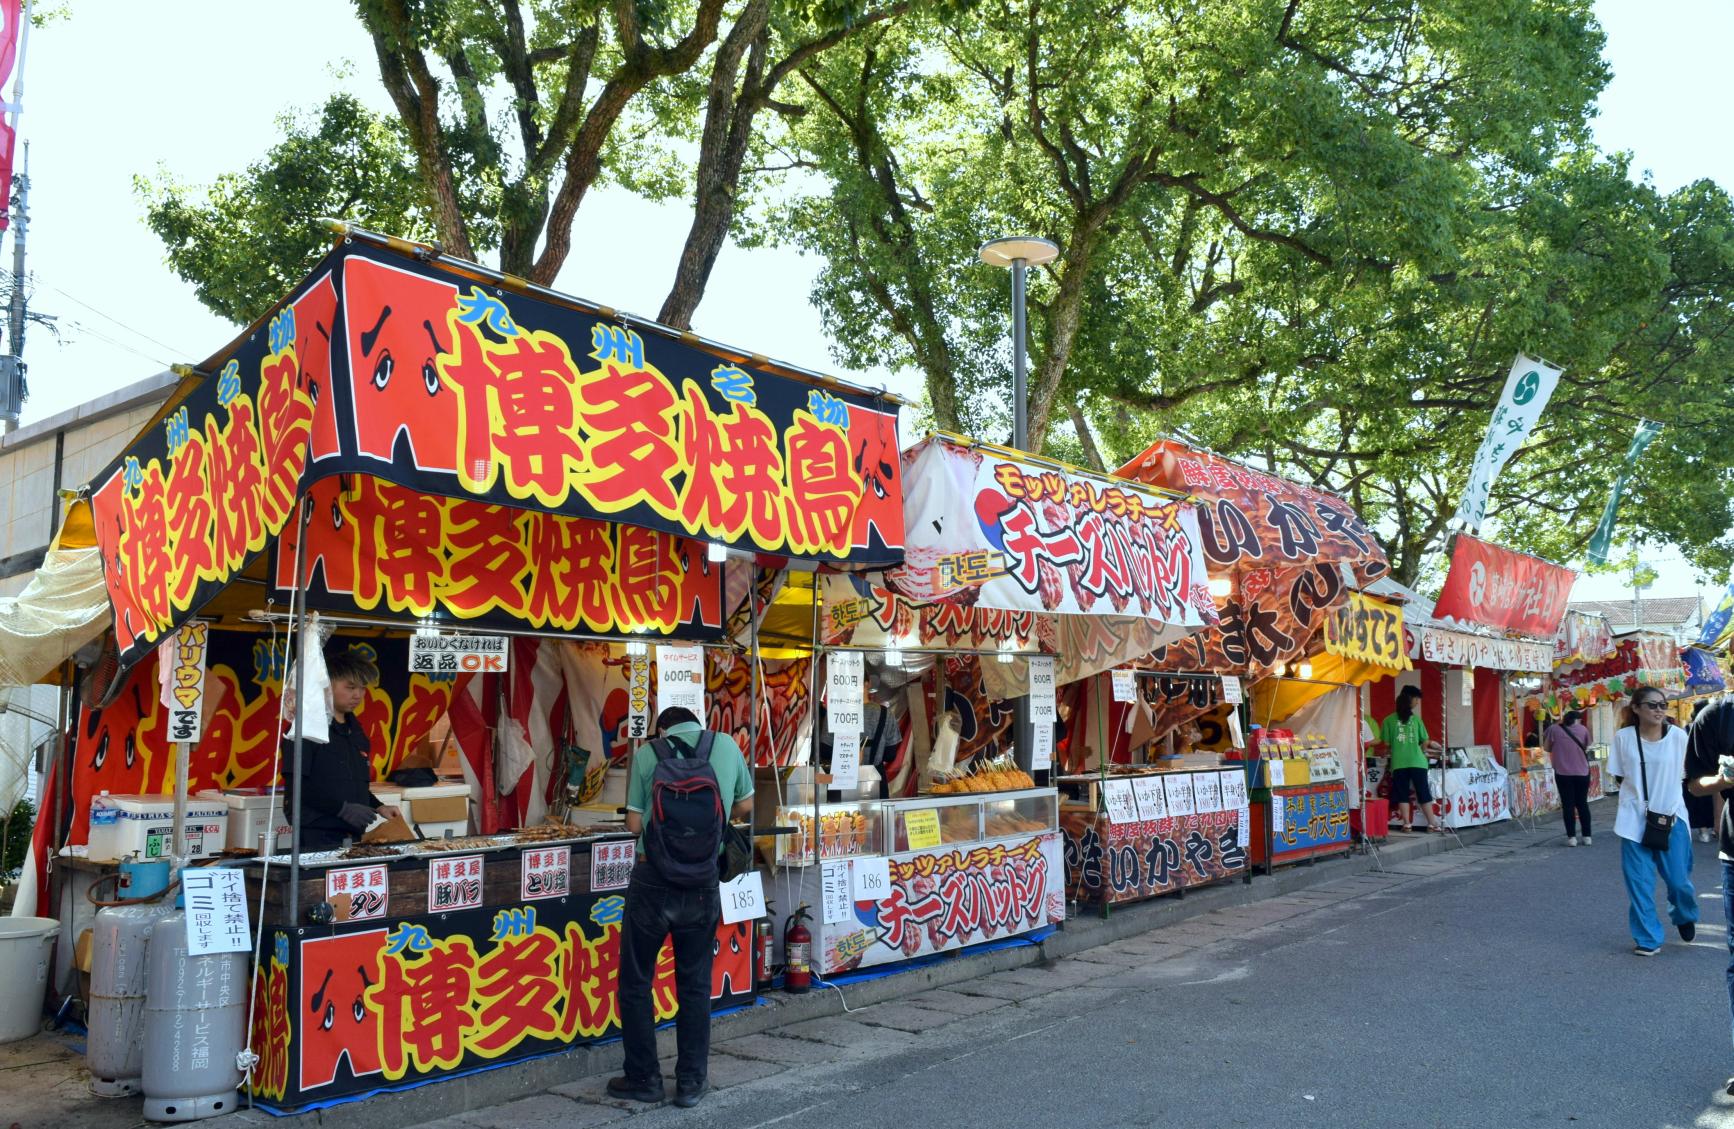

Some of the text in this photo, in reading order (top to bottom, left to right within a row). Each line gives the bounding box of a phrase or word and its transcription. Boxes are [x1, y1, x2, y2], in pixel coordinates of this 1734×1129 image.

[455, 286, 850, 431] 九州名物
[123, 303, 295, 495] 九州名物
[436, 307, 864, 558] 博多焼鳥
[121, 352, 314, 642] 博多焼鳥
[994, 463, 1182, 531] モッツァレラチーズ
[1197, 493, 1387, 577] いかや
[340, 473, 682, 636] 博多焼鳥
[1001, 502, 1192, 606] チーズハットグ
[414, 636, 505, 652] おいしくなければ
[663, 653, 698, 662] タイムサービス
[413, 653, 503, 671] 返品OK
[173, 623, 206, 740] バリウマです
[664, 670, 693, 682] 600円
[833, 675, 858, 687] 600円
[1034, 674, 1052, 684] 600円
[834, 713, 858, 725] 700円
[1035, 706, 1052, 715] 700円
[436, 860, 480, 878] 博多屋
[528, 851, 568, 868] 博多屋
[1109, 826, 1246, 892] いかやき
[332, 870, 383, 890] 博多屋
[434, 880, 481, 907] 豚バラ
[862, 873, 882, 889] 186
[186, 871, 217, 948] ゴミ回収します
[220, 871, 245, 946] ポイ捨て禁止!!
[350, 890, 387, 917] タン
[731, 889, 755, 910] 185
[876, 854, 1049, 950] チーズハットグ
[385, 895, 626, 955] 九州名
